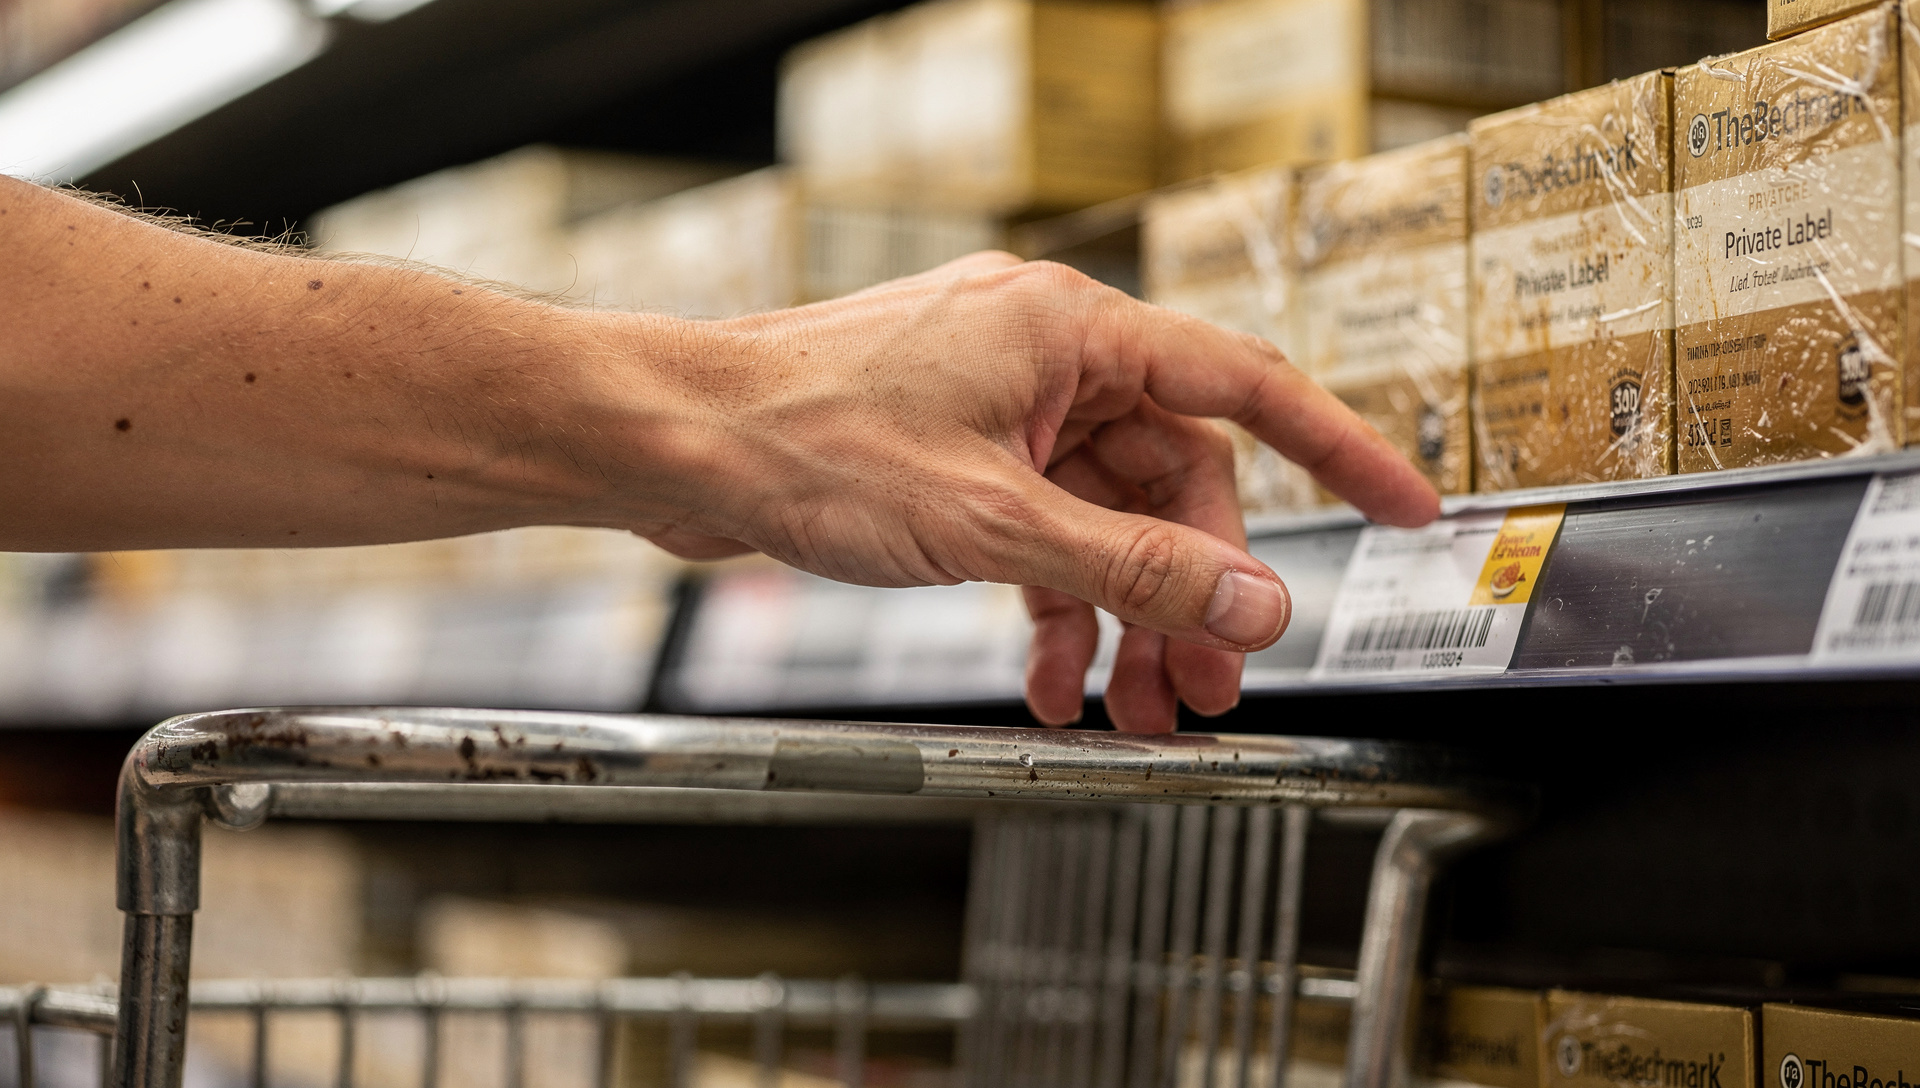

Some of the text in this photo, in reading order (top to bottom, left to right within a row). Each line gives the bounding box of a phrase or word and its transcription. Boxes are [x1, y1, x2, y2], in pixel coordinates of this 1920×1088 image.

[1725, 207, 1833, 259] Private Label
[1568, 252, 1610, 289] Label
